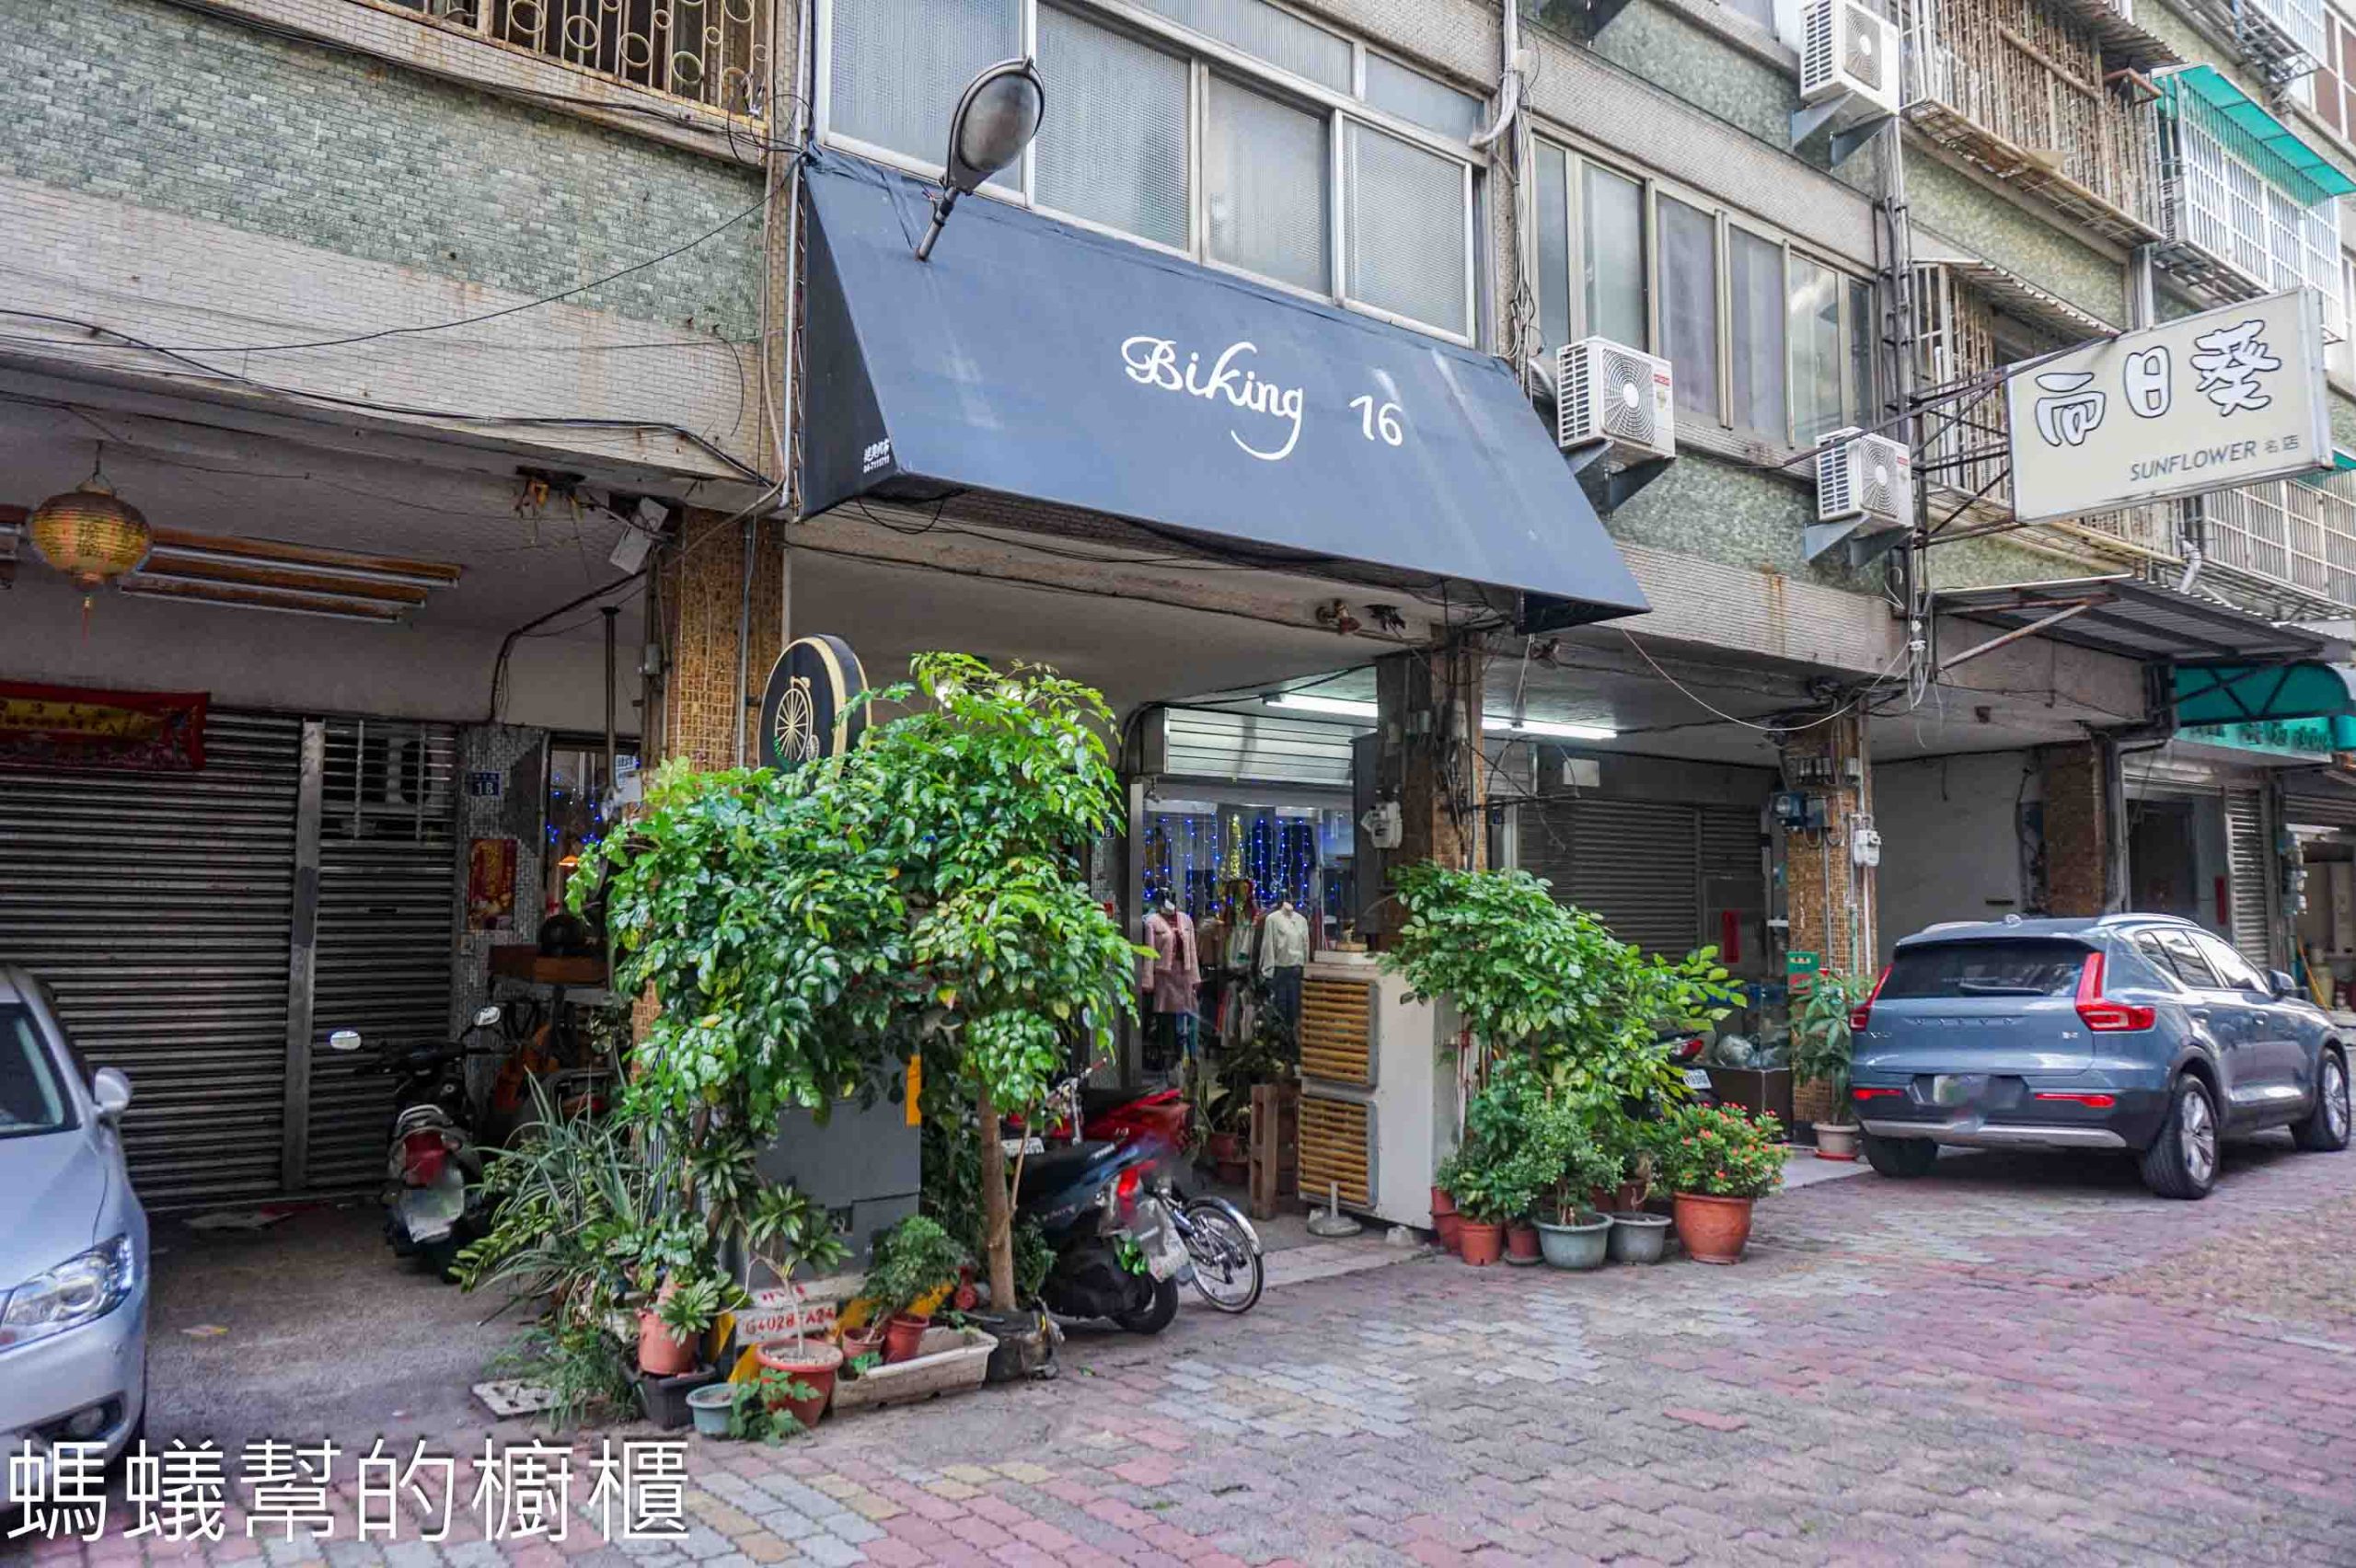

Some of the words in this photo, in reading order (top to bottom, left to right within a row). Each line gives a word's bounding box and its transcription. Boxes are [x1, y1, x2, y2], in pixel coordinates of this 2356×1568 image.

[1121, 336, 1303, 461] Biking
[1348, 395, 1403, 446] 16
[2130, 440, 2258, 482] SUNFLOWER
